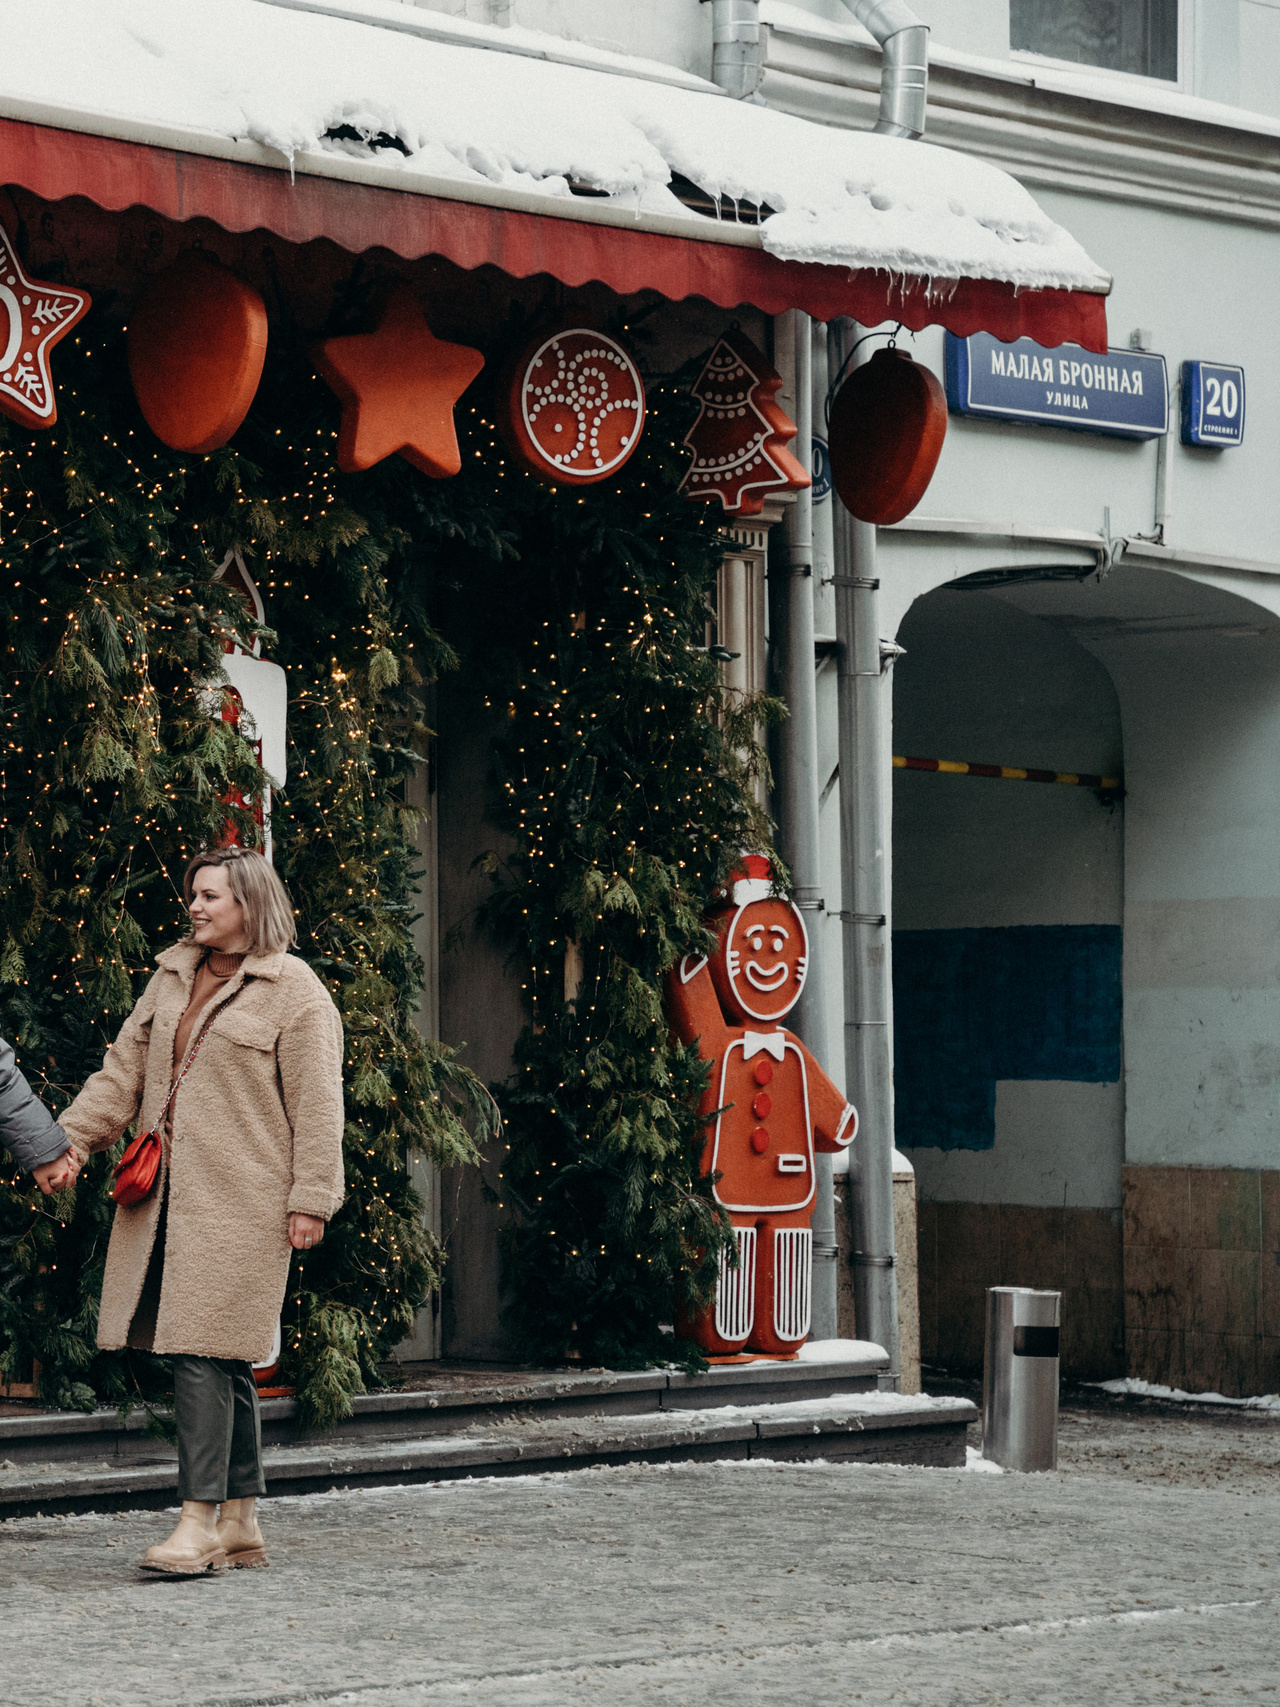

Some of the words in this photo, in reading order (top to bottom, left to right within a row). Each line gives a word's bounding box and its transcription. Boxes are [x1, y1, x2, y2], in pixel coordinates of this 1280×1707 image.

[990, 349, 1054, 383] МАЛАЯ
[1059, 360, 1144, 396] БРОННАЯ
[1046, 391, 1089, 410] УЛИЦА
[1205, 377, 1238, 418] 20
